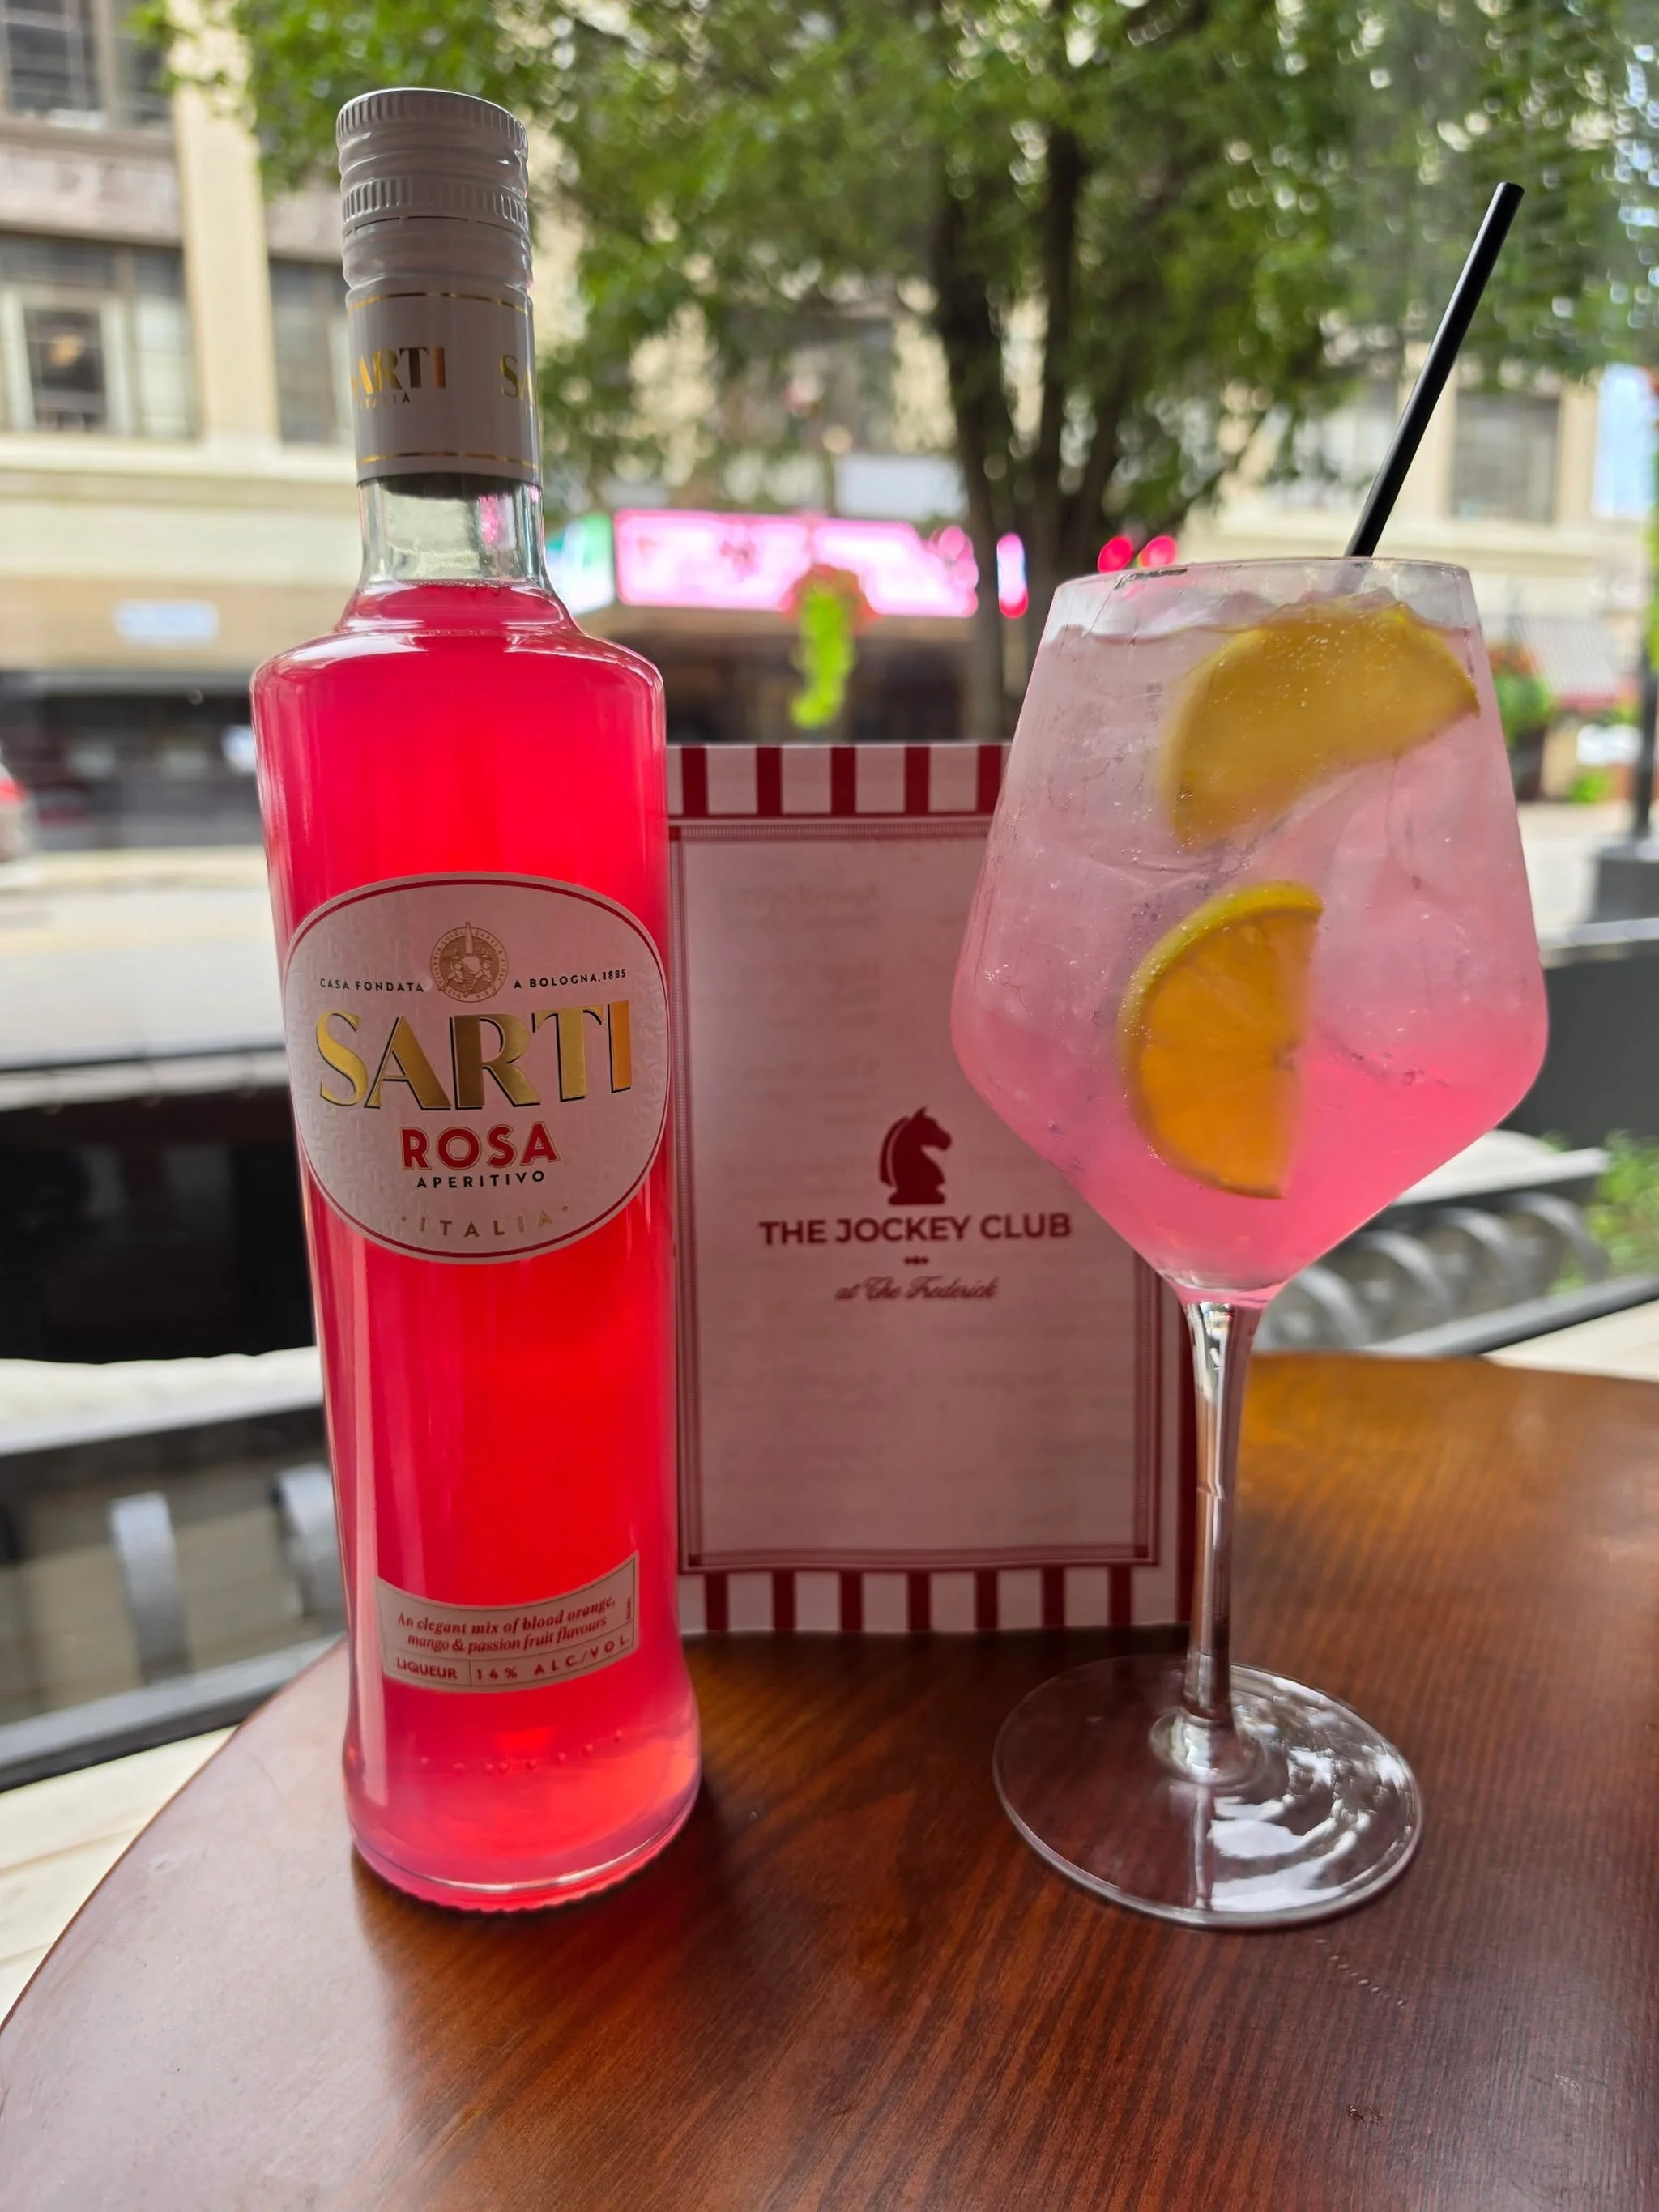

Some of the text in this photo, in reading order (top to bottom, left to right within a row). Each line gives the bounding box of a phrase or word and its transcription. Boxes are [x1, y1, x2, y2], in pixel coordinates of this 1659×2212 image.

[320, 978, 350, 991] CASA
[356, 981, 424, 993] FONDATA
[514, 980, 522, 989] A
[316, 1001, 633, 1110] SARTI
[400, 1122, 561, 1170] ROSA
[417, 1170, 545, 1188] APERITIVO
[420, 1211, 554, 1238] ITALIA
[759, 1212, 1072, 1245] THE JOCKEY CLUB
[834, 1282, 861, 1300] at
[862, 1276, 903, 1301] The
[398, 1612, 413, 1627] An
[417, 1618, 467, 1634] elegant
[471, 1623, 499, 1634] mix
[503, 1618, 519, 1635] of
[522, 1609, 564, 1630] blood
[568, 1596, 616, 1621] orange,
[408, 1617, 608, 1654] mango & passion fruit flavours
[397, 1658, 458, 1679] LIQUEUR
[476, 1666, 518, 1680] 14%
